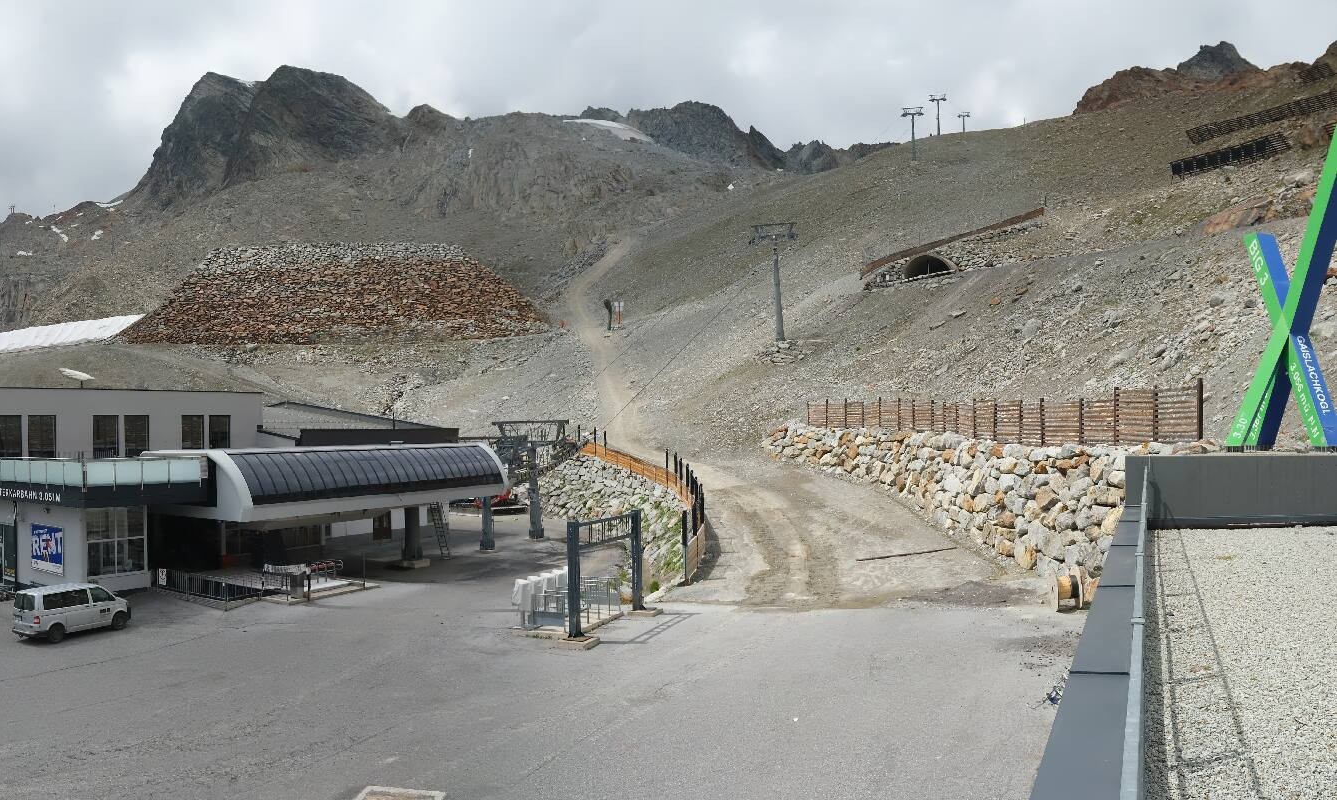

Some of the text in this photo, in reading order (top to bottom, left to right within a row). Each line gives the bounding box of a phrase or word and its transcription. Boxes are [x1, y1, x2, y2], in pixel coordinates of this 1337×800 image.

[1248, 238, 1269, 286] BIG 3
[31, 532, 63, 556] RENT
